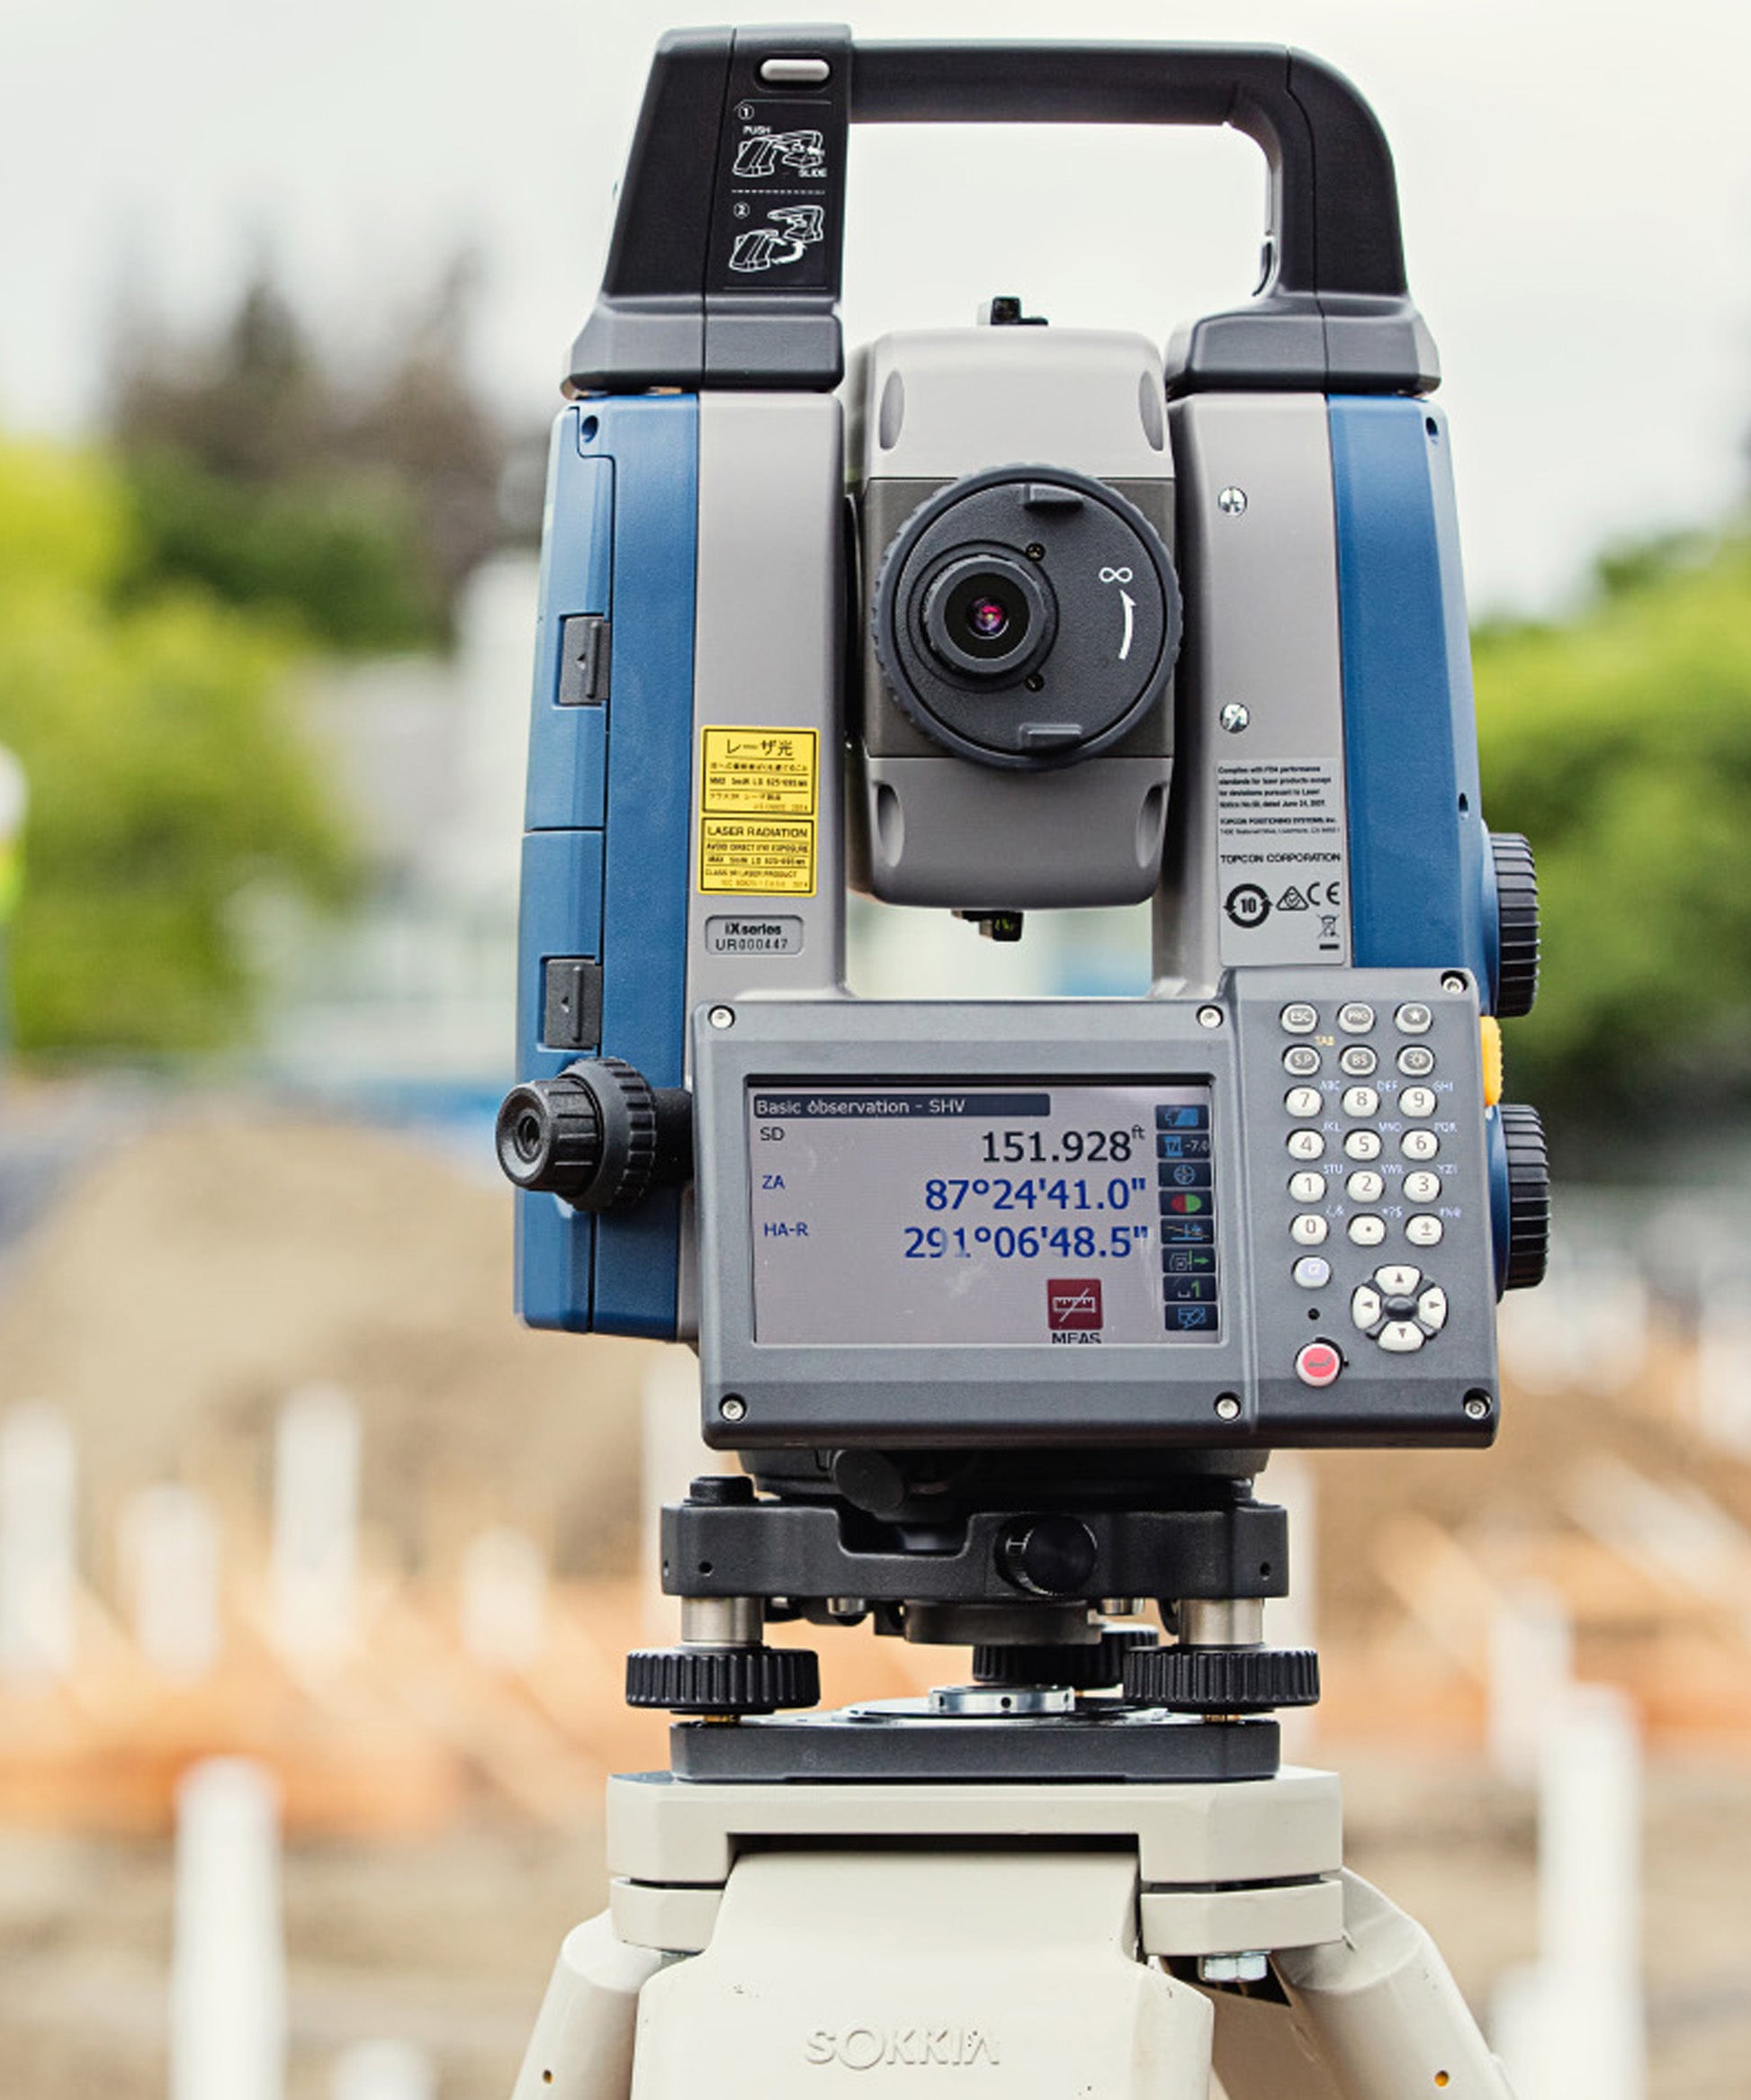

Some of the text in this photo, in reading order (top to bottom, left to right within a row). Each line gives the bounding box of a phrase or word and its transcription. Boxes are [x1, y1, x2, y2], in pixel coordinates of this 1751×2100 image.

[742, 126, 771, 135] PUSH
[798, 168, 827, 177] SLIDE
[726, 739, 793, 756] レーザ光
[1280, 767, 1321, 775] performance
[1280, 777, 1308, 785] products
[707, 826, 808, 838] LASER RADIATION
[1220, 852, 1341, 864] TOPCON CORPORATION
[1241, 897, 1256, 913] 10
[715, 938, 788, 951] UR000447
[1320, 1081, 1341, 1090] ABC
[1377, 1081, 1398, 1091] DEF
[1432, 1081, 1454, 1091] GHI
[1300, 1092, 1311, 1108] 7
[1356, 1091, 1368, 1107] 8
[1414, 1091, 1425, 1108] 9
[756, 1099, 801, 1115] Basic
[808, 1099, 910, 1115] observation
[929, 1099, 966, 1114] SHV
[1322, 1123, 1341, 1132] JKL
[1378, 1123, 1403, 1132] MNO
[1434, 1123, 1458, 1132] PQR
[759, 1126, 786, 1142] SD
[982, 1130, 1132, 1163] 151.928
[1300, 1137, 1312, 1153] 4
[1359, 1136, 1369, 1153] 5
[1415, 1135, 1427, 1152] 6
[1323, 1164, 1343, 1174] STU
[1304, 1178, 1313, 1193] 1
[1361, 1175, 1372, 1192] 2
[1418, 1176, 1430, 1192] 3
[761, 1174, 1147, 1211] ZA 87°24'41.0"
[1305, 1218, 1316, 1234] 0
[764, 1222, 1149, 1259] HA-R 291°06'48.5"
[1052, 1332, 1102, 1344] MEAS
[806, 2028, 1000, 2071] SOKKIA
